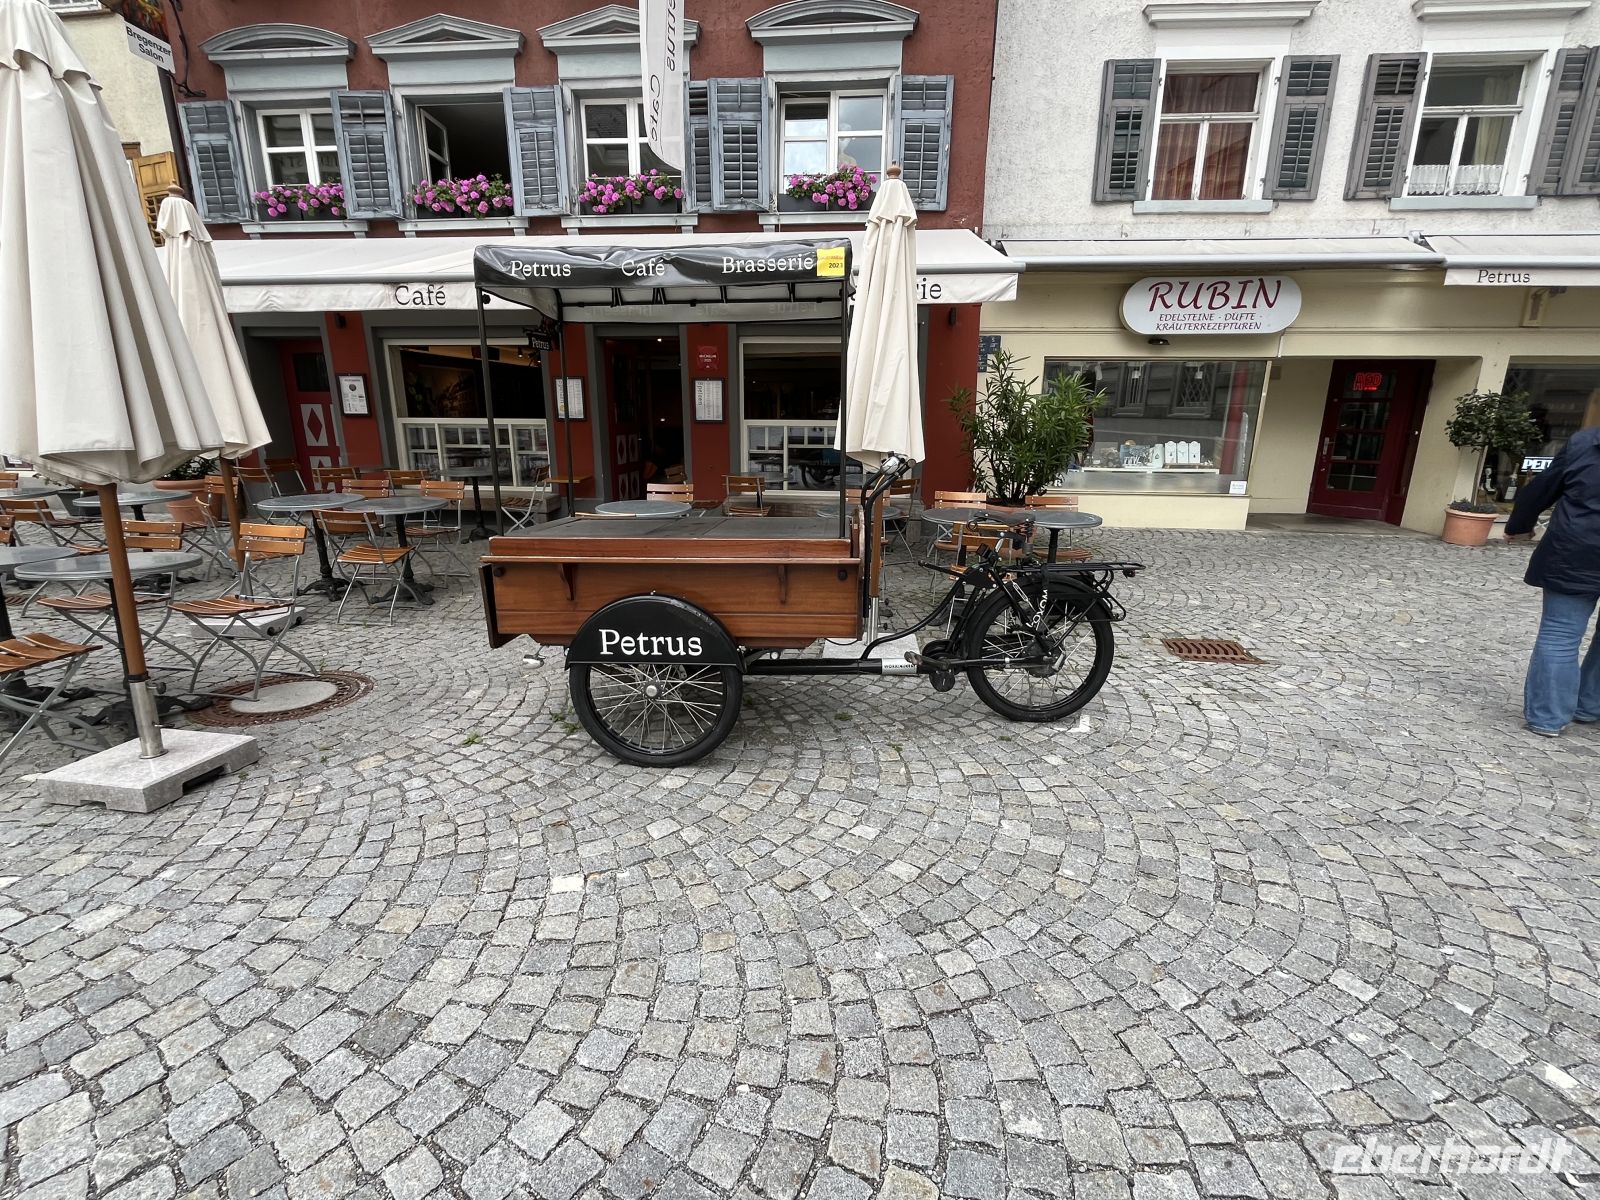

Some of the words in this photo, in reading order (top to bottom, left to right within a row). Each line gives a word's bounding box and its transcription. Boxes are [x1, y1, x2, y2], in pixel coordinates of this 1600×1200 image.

[126, 26, 171, 56] Bregenzer
[138, 43, 164, 63] Salon
[510, 260, 572, 277] Petrus
[621, 258, 666, 277] Café
[722, 252, 815, 274] Brasserie
[1477, 269, 1531, 283] Petrus
[394, 283, 447, 306] Café
[1148, 277, 1282, 312] RUBIN
[1155, 321, 1262, 331] KRÄUTERREZEPTUREN
[1159, 313, 1215, 322] EDELSTEINE
[1224, 312, 1256, 321] DÜFTE
[599, 628, 703, 656] Petrus
